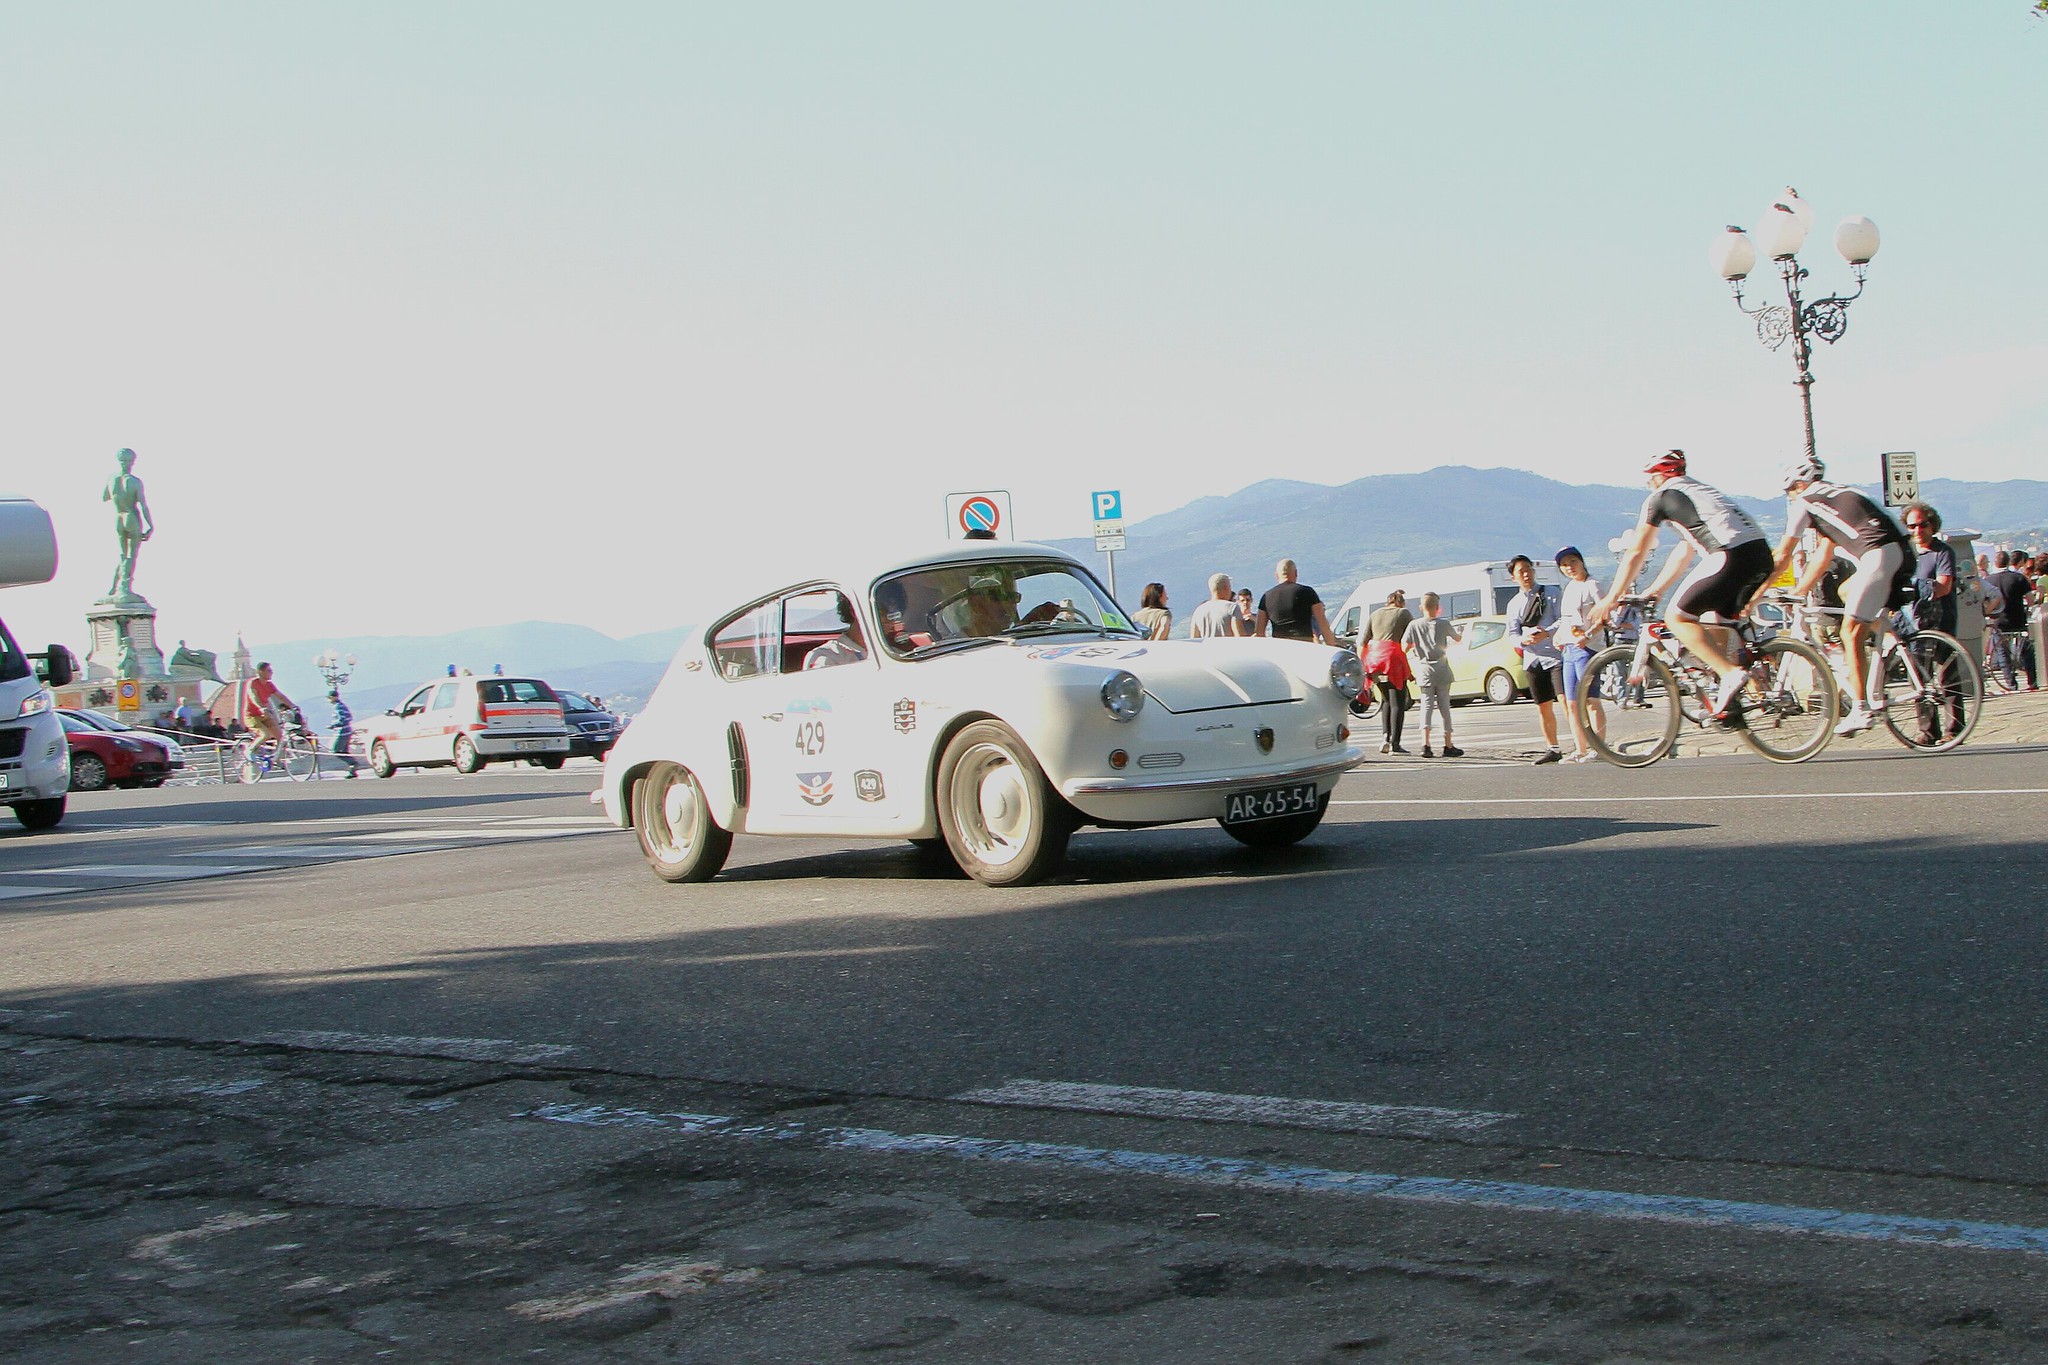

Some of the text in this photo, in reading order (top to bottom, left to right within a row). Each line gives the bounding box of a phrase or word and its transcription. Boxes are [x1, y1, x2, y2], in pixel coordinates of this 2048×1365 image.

[1097, 494, 1116, 518] P
[796, 721, 825, 755] 429
[860, 778, 878, 790] 429
[1229, 786, 1315, 820] AR-65-54
